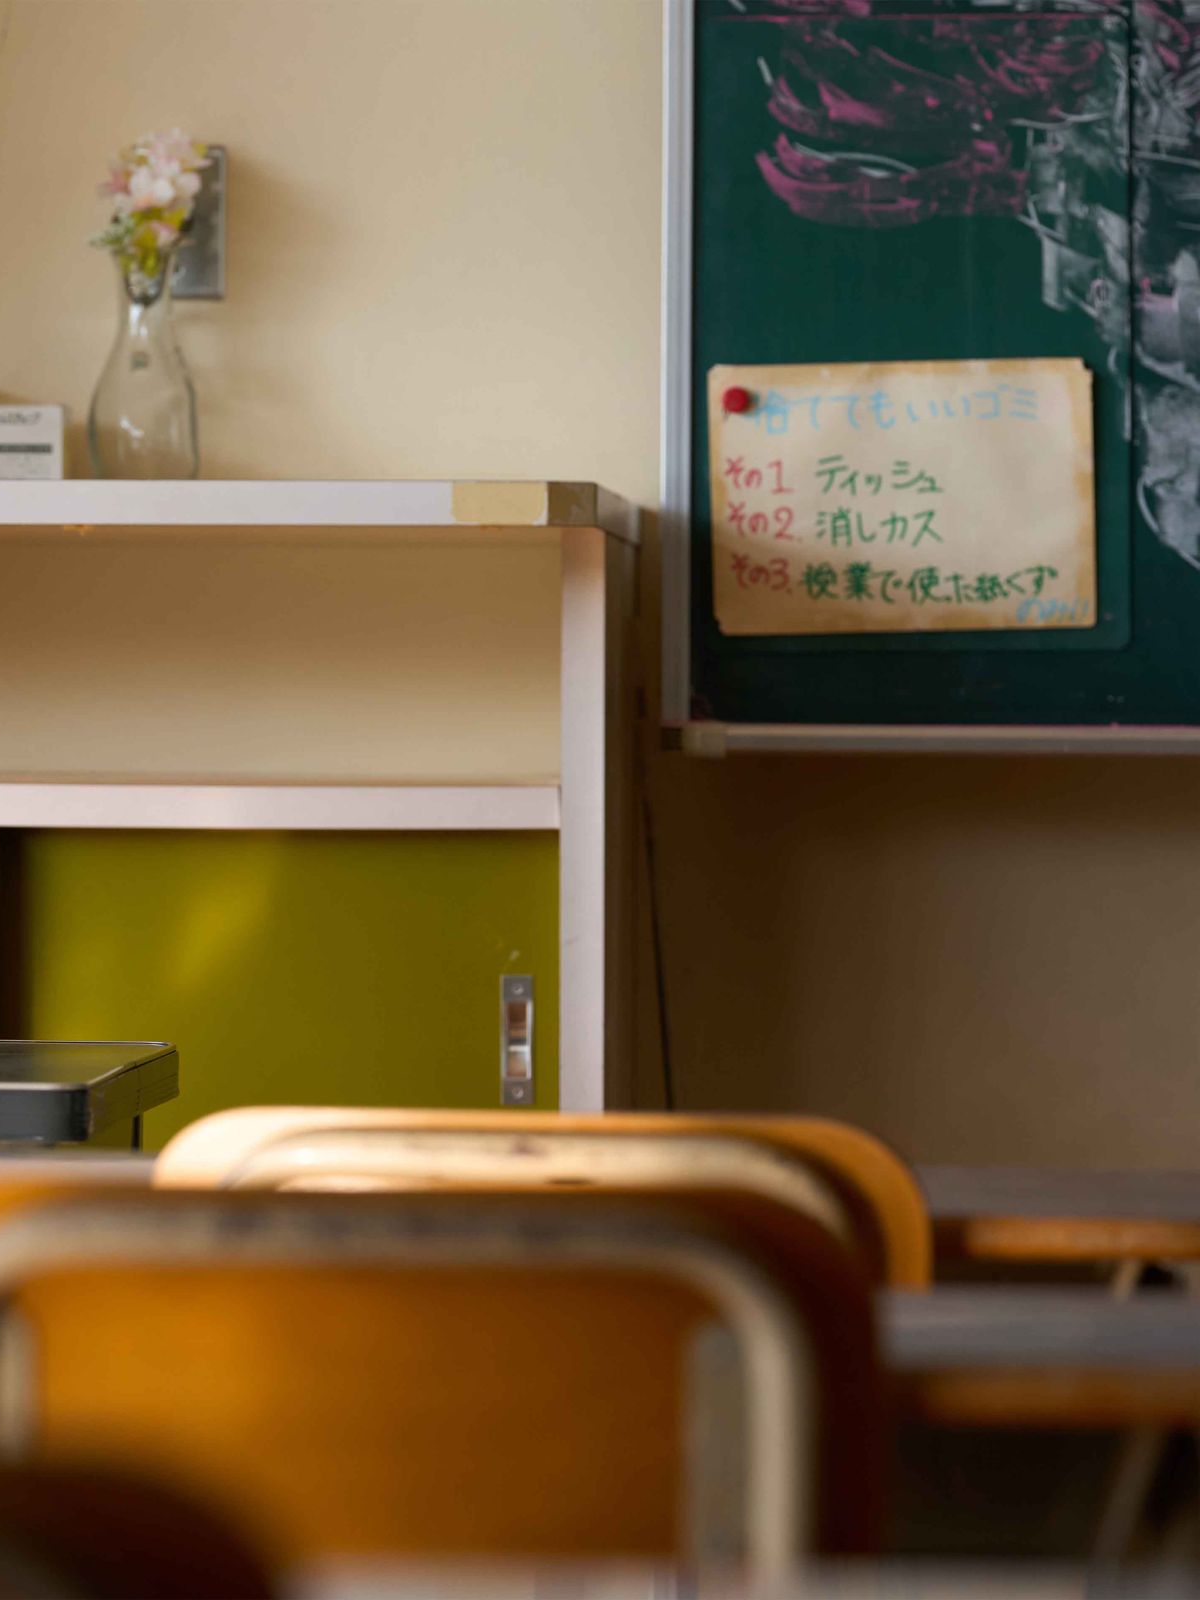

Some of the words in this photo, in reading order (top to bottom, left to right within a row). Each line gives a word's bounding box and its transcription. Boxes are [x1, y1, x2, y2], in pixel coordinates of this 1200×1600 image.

[725, 456, 794, 495] その1
[816, 455, 944, 495] ティッシュ
[816, 506, 944, 547] 消しカス
